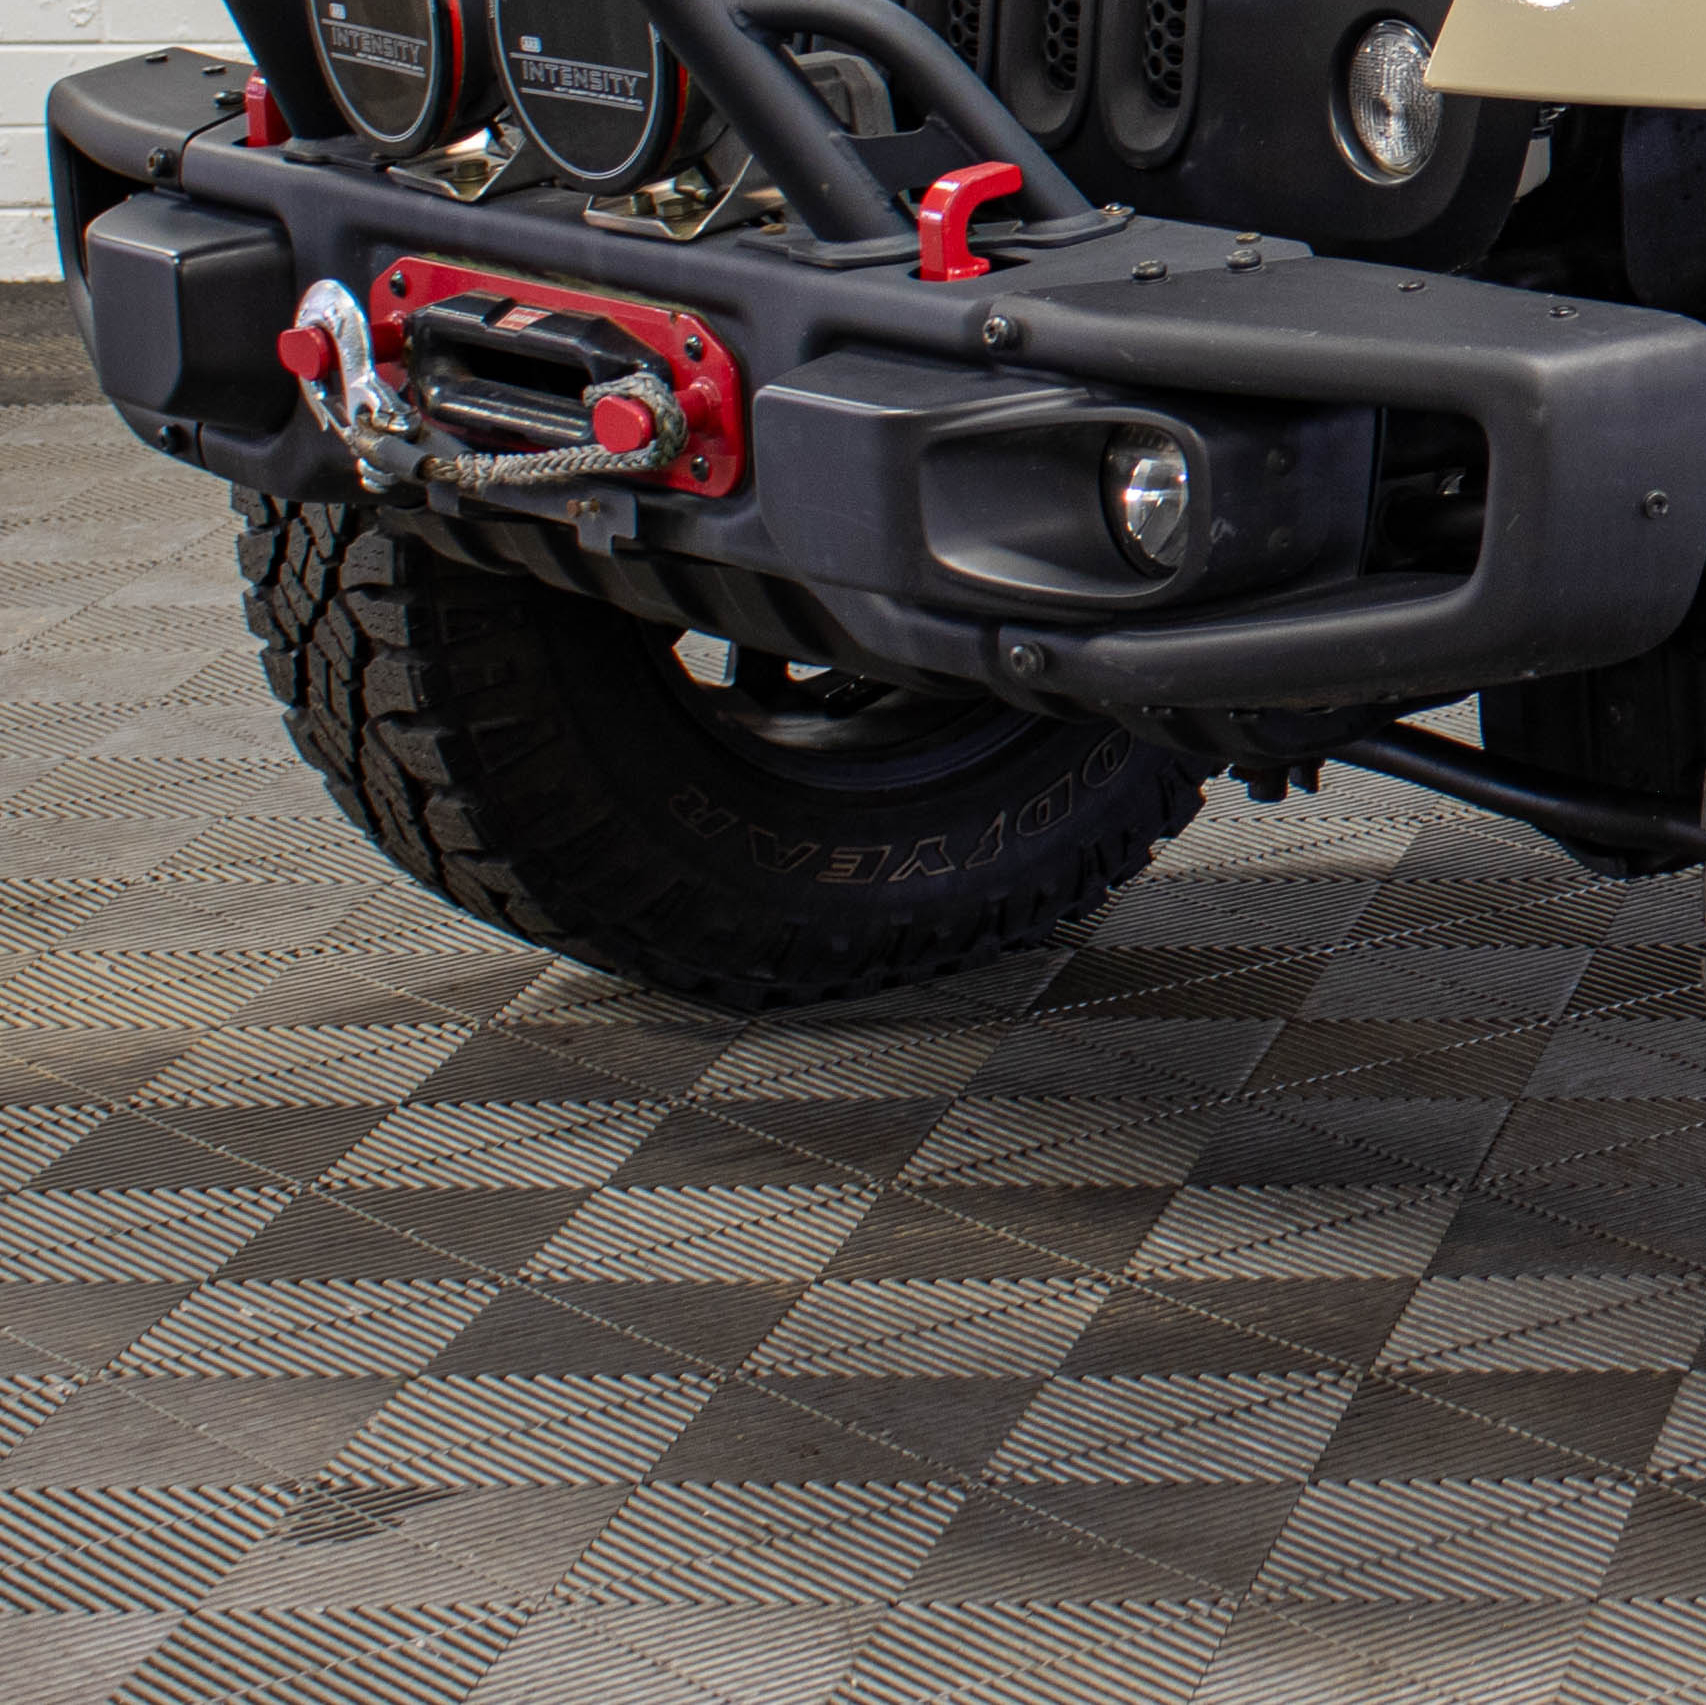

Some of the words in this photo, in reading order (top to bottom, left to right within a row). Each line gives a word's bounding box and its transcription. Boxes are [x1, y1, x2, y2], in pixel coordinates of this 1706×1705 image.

[331, 25, 420, 64] INTENSITY
[521, 59, 638, 96] INTENSITY
[670, 724, 1136, 886] ODYEAR
